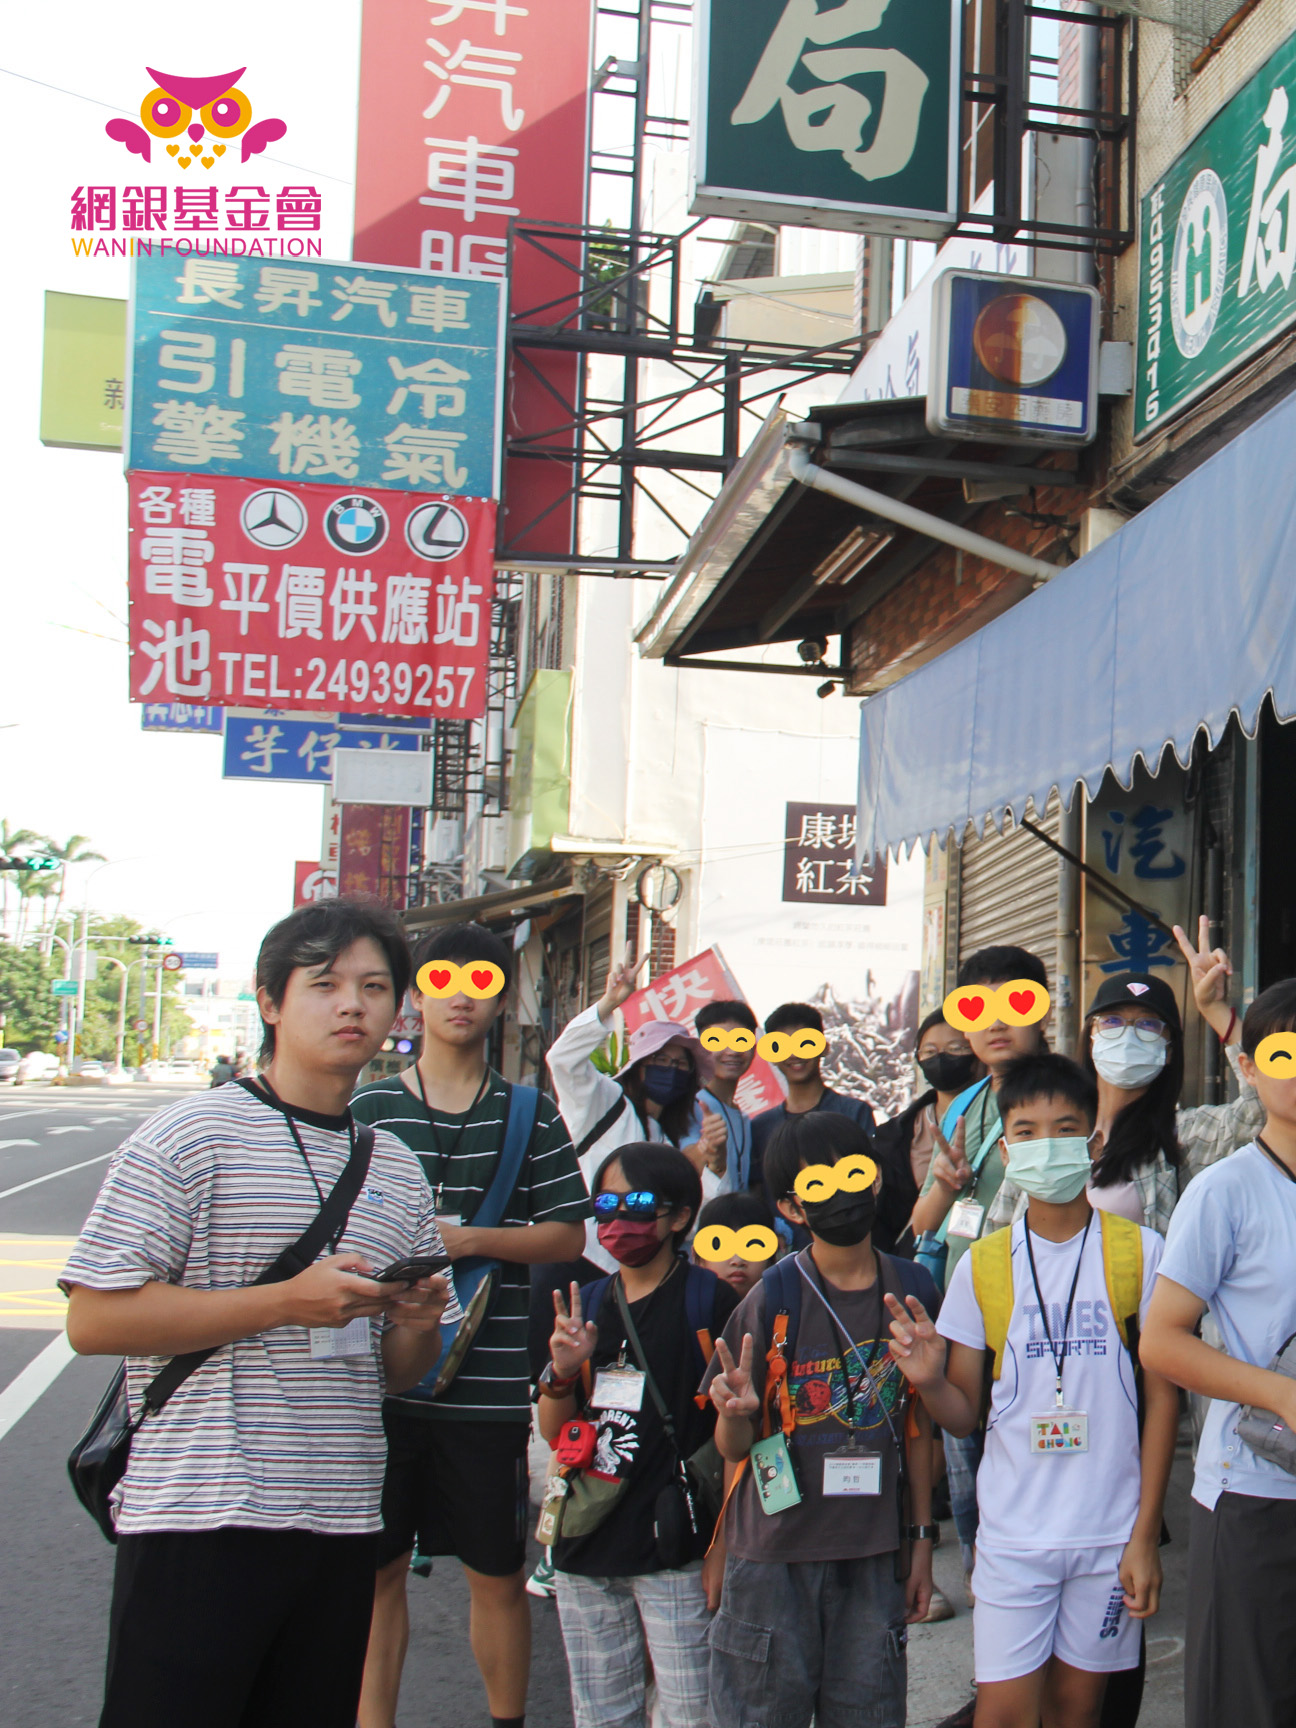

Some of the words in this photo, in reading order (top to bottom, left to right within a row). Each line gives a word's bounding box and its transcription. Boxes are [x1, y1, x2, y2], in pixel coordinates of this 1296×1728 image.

[730, 0, 929, 181] 局
[176, 258, 470, 332] 長昇汽車
[138, 486, 216, 528] 各種
[139, 528, 213, 698] 電池
[220, 562, 482, 646] 平價供應站
[217, 651, 475, 709] TEL:24939257
[796, 857, 873, 896] 紅茶
[1022, 1300, 1109, 1340] TIMES
[1026, 1339, 1107, 1358] SPORTS
[1037, 1422, 1069, 1435] TAI
[1038, 1436, 1082, 1449] CHUNG
